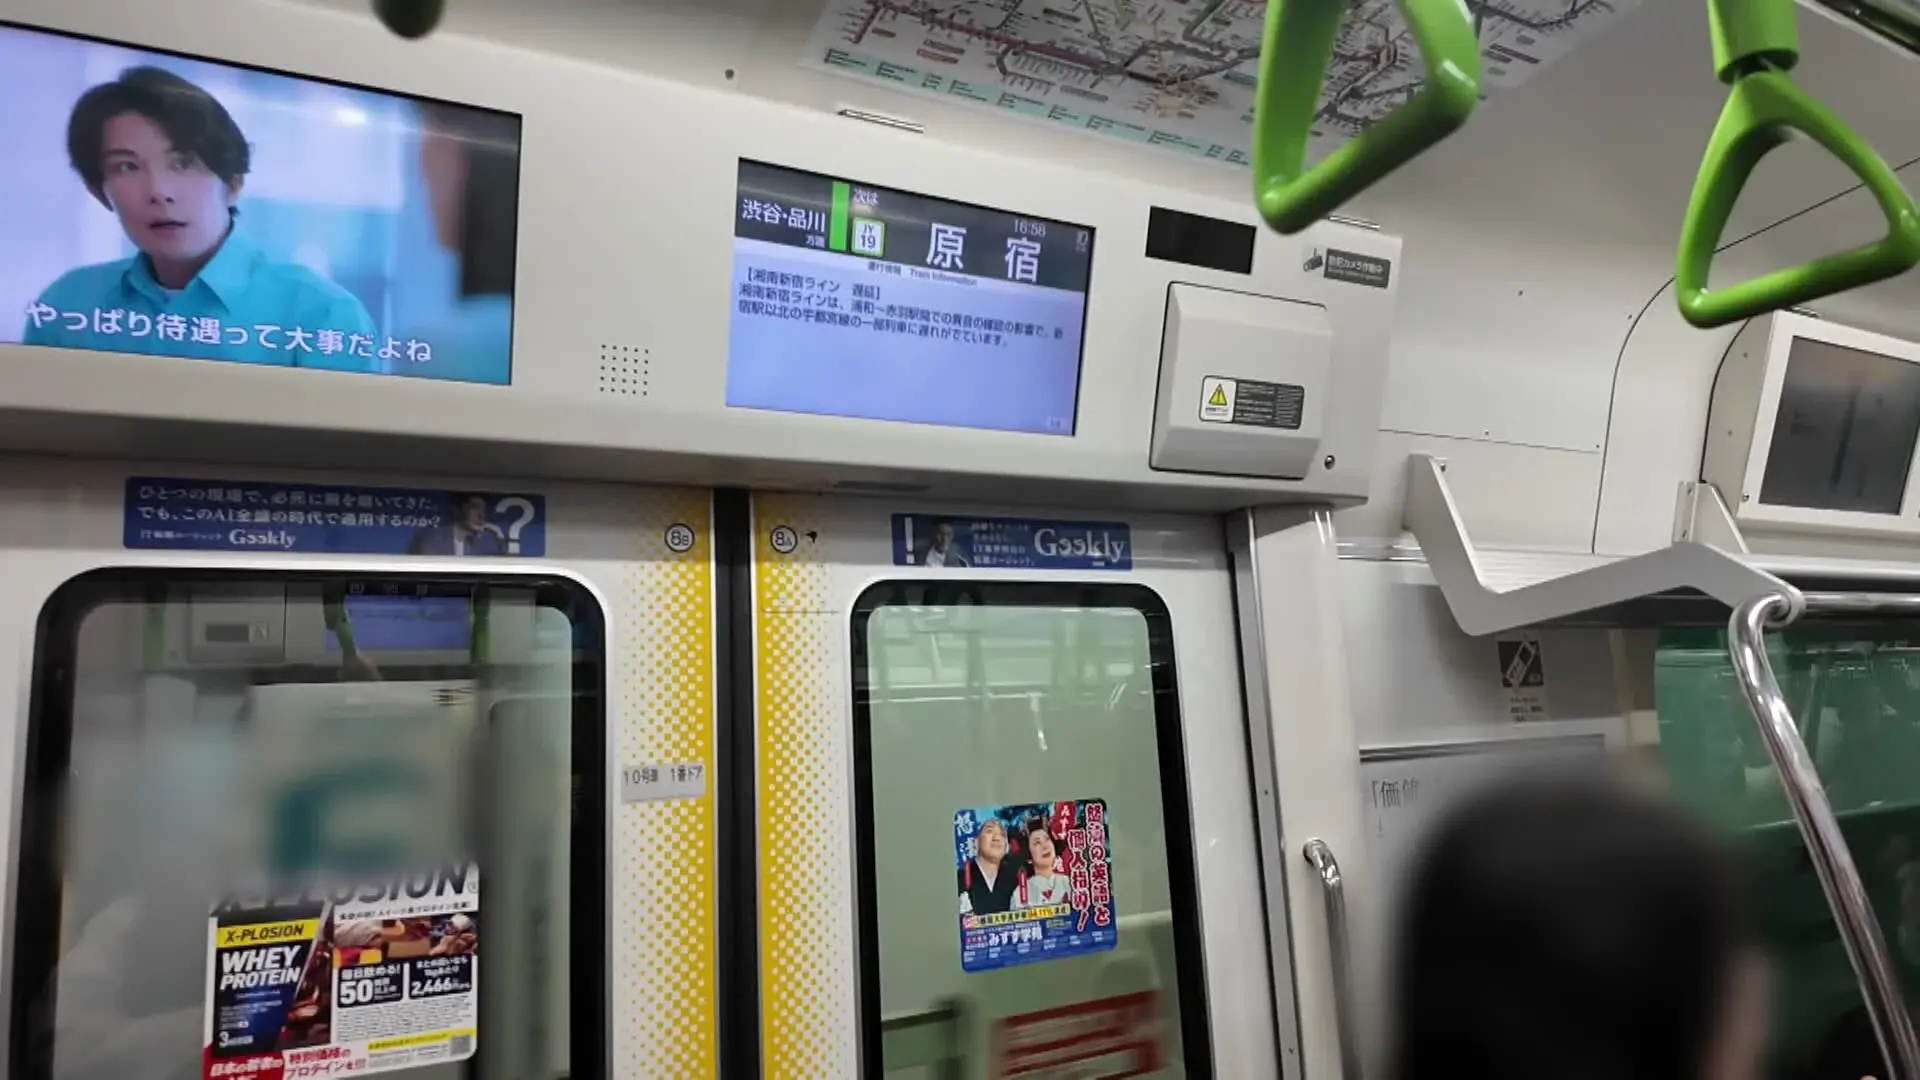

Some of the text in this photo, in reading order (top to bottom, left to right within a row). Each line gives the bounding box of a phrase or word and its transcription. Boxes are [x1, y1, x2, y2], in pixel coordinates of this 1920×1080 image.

[853, 187, 880, 206] 次は
[742, 199, 826, 234] 渋谷・品川
[860, 234, 877, 250] 19
[26, 302, 433, 364] やっぱり待遇って大事だよね
[670, 529, 690, 547] 8B
[1033, 527, 1126, 564] Geekly
[224, 923, 305, 945] X-PLOSION
[222, 944, 302, 973] WHEY
[220, 967, 301, 990] PROTEIN
[340, 979, 374, 1005] 50
